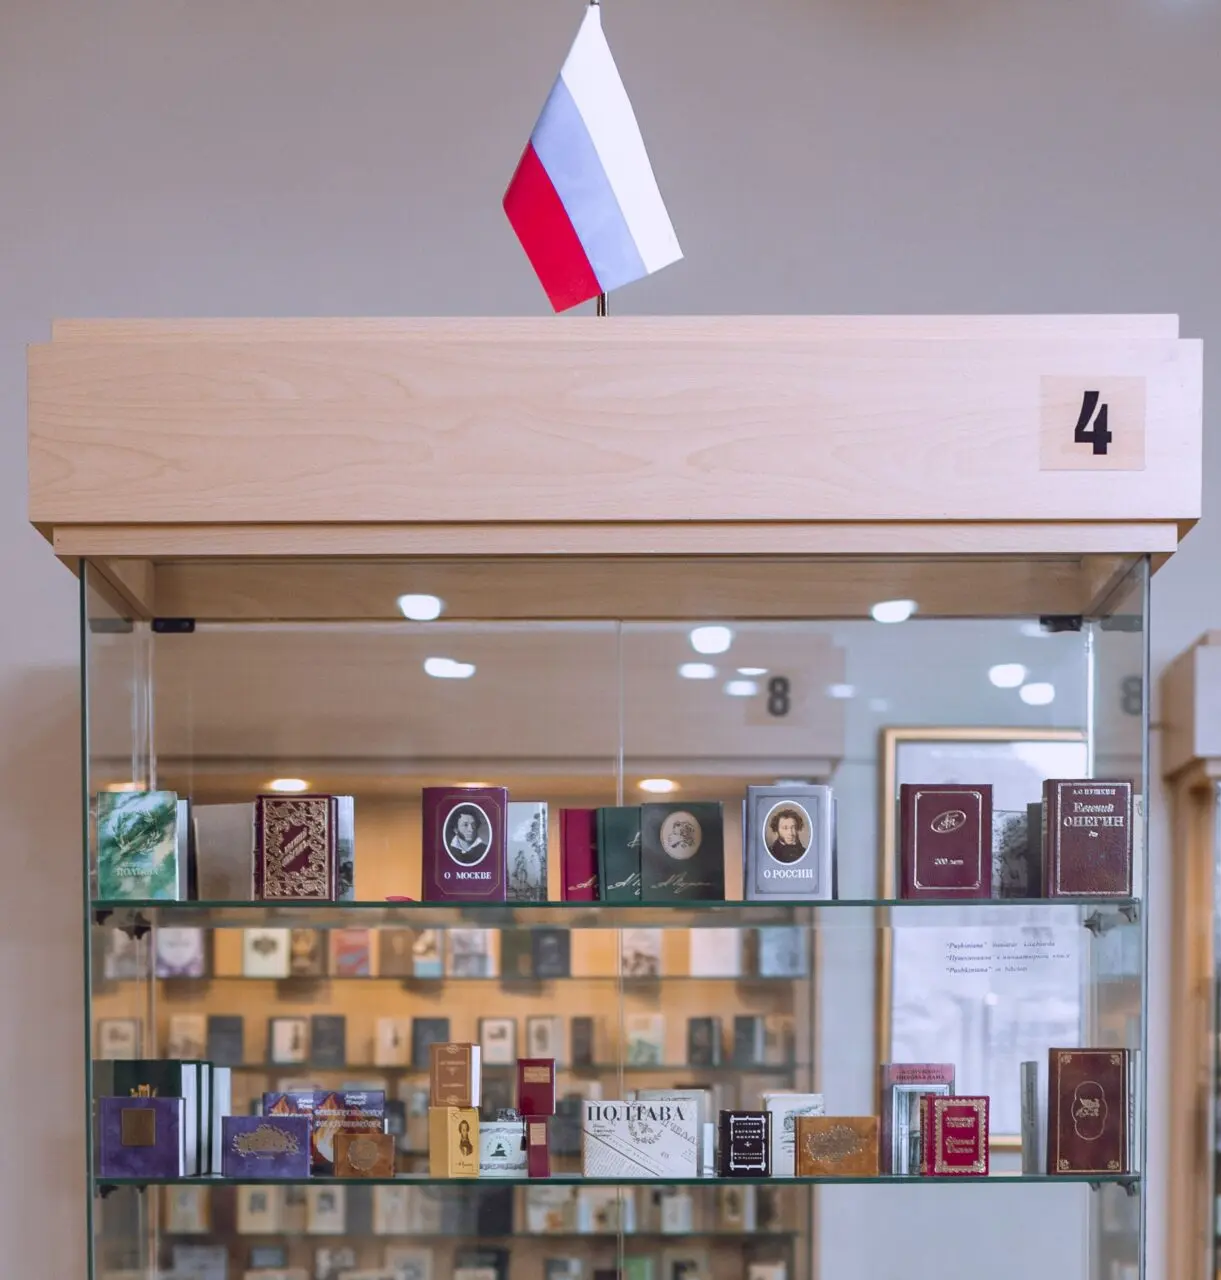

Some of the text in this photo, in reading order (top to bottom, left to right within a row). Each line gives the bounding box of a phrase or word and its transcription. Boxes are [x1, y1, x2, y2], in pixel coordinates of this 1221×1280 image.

[1074, 391, 1113, 455] 4
[767, 676, 791, 717] 8
[1063, 816, 1124, 827] ОНЕГИН
[444, 870, 492, 880] О МОСКВЕ
[763, 868, 813, 880] О РОССИИ
[587, 1105, 685, 1121] ПОЛТАВА
